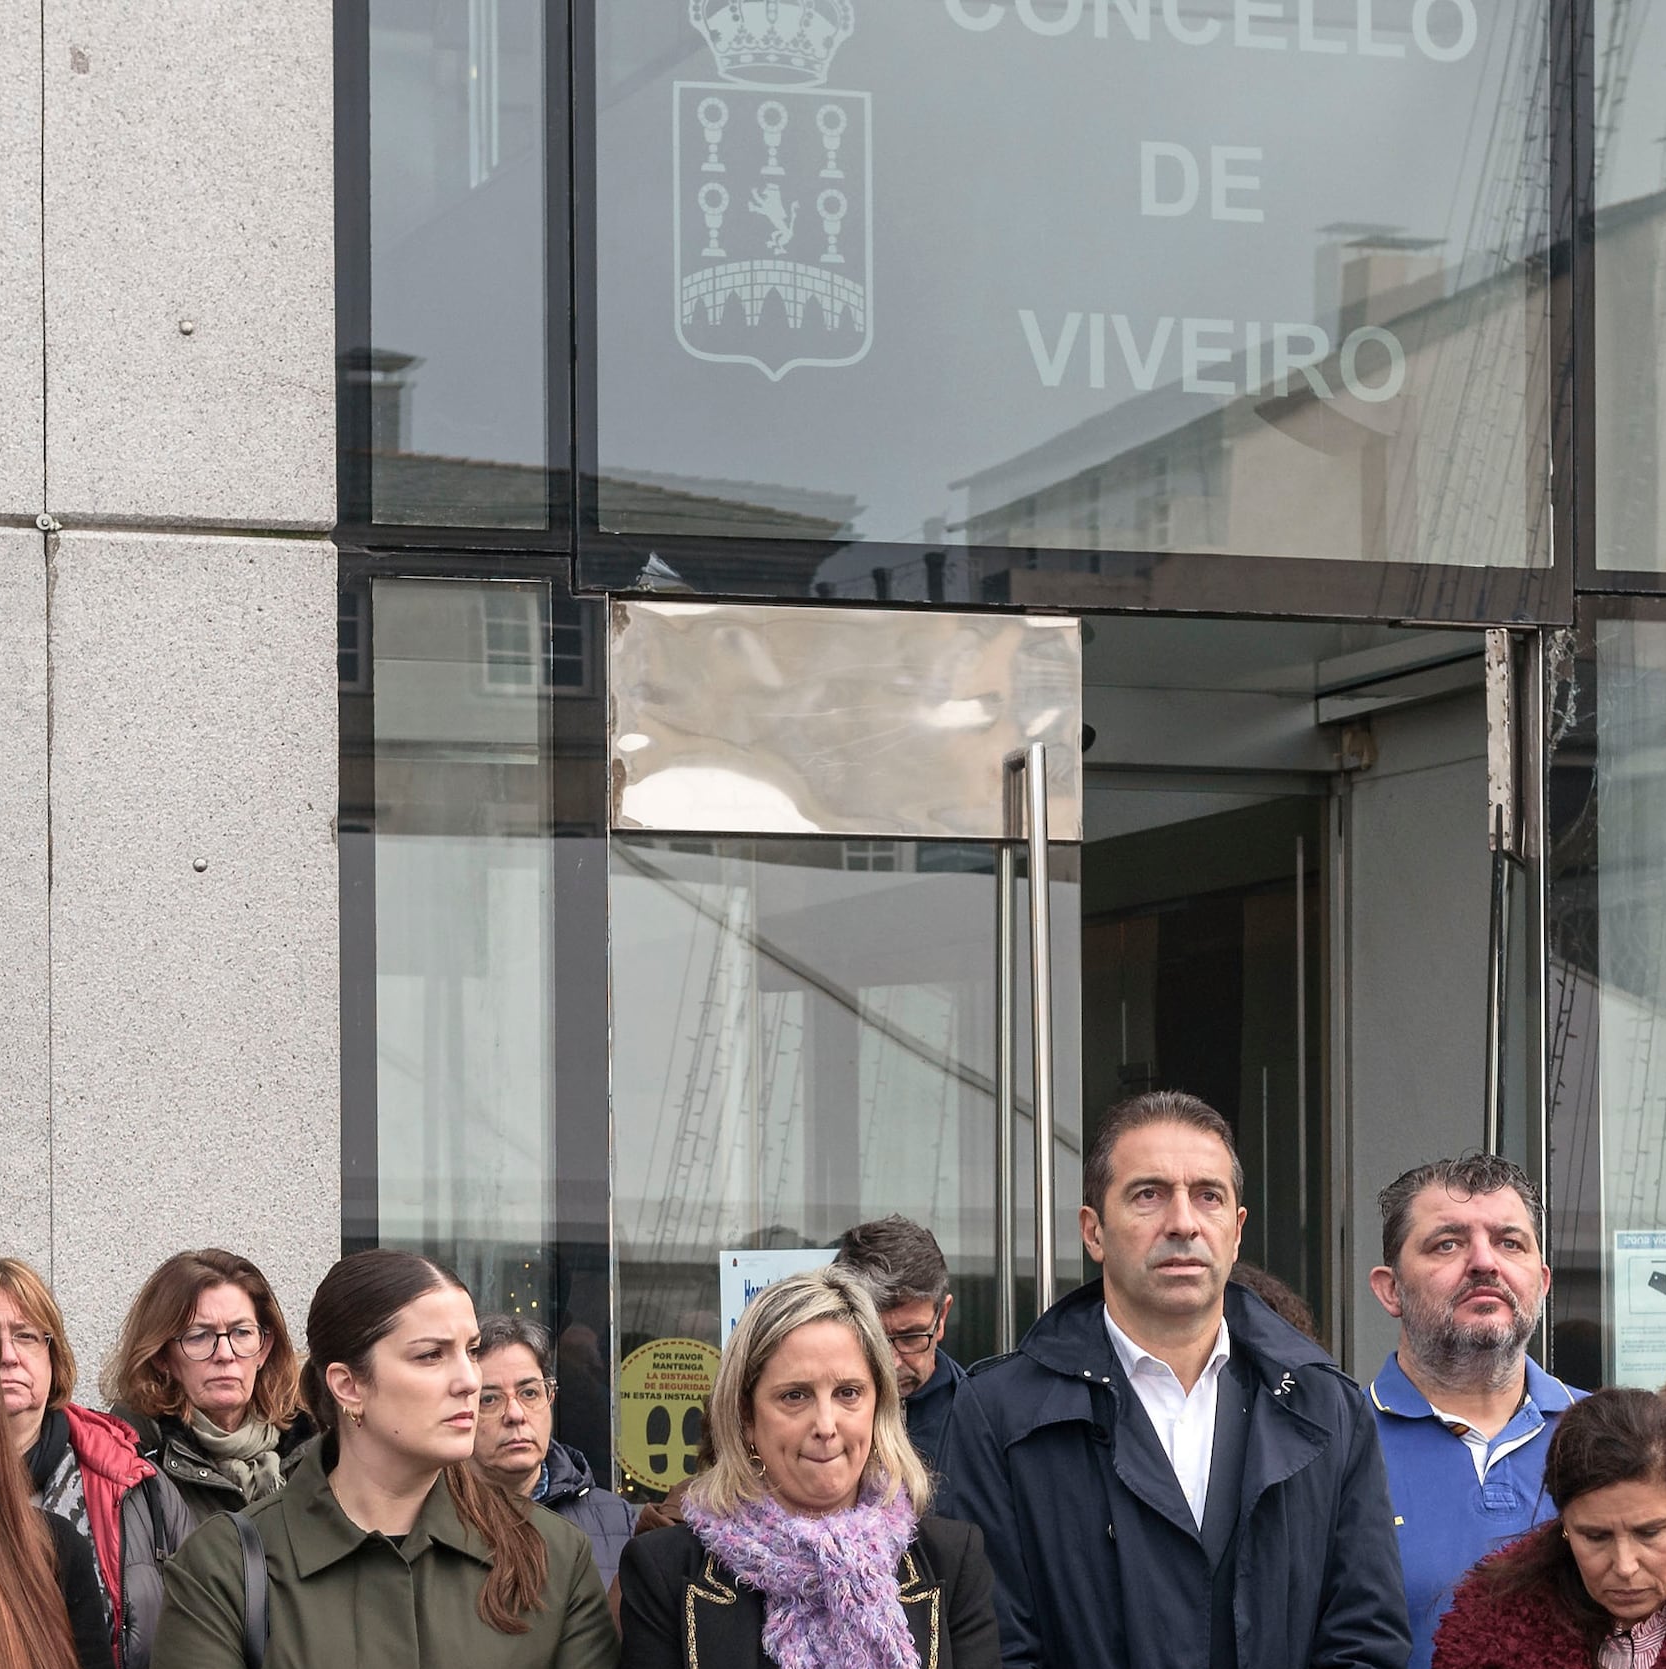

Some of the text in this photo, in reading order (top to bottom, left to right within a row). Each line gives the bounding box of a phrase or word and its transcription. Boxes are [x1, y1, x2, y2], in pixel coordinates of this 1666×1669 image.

[1140, 140, 1265, 224] DE
[1018, 309, 1406, 402] VIVEIRO
[653, 1352, 704, 1361] POR FAVOR
[652, 1362, 704, 1371] MANTENGA
[646, 1372, 710, 1381] LA DISTANCIA
[644, 1382, 711, 1391] DE SEGURIDAD
[633, 1391, 662, 1400] ESTAS
[664, 1393, 708, 1401] INSTALA
